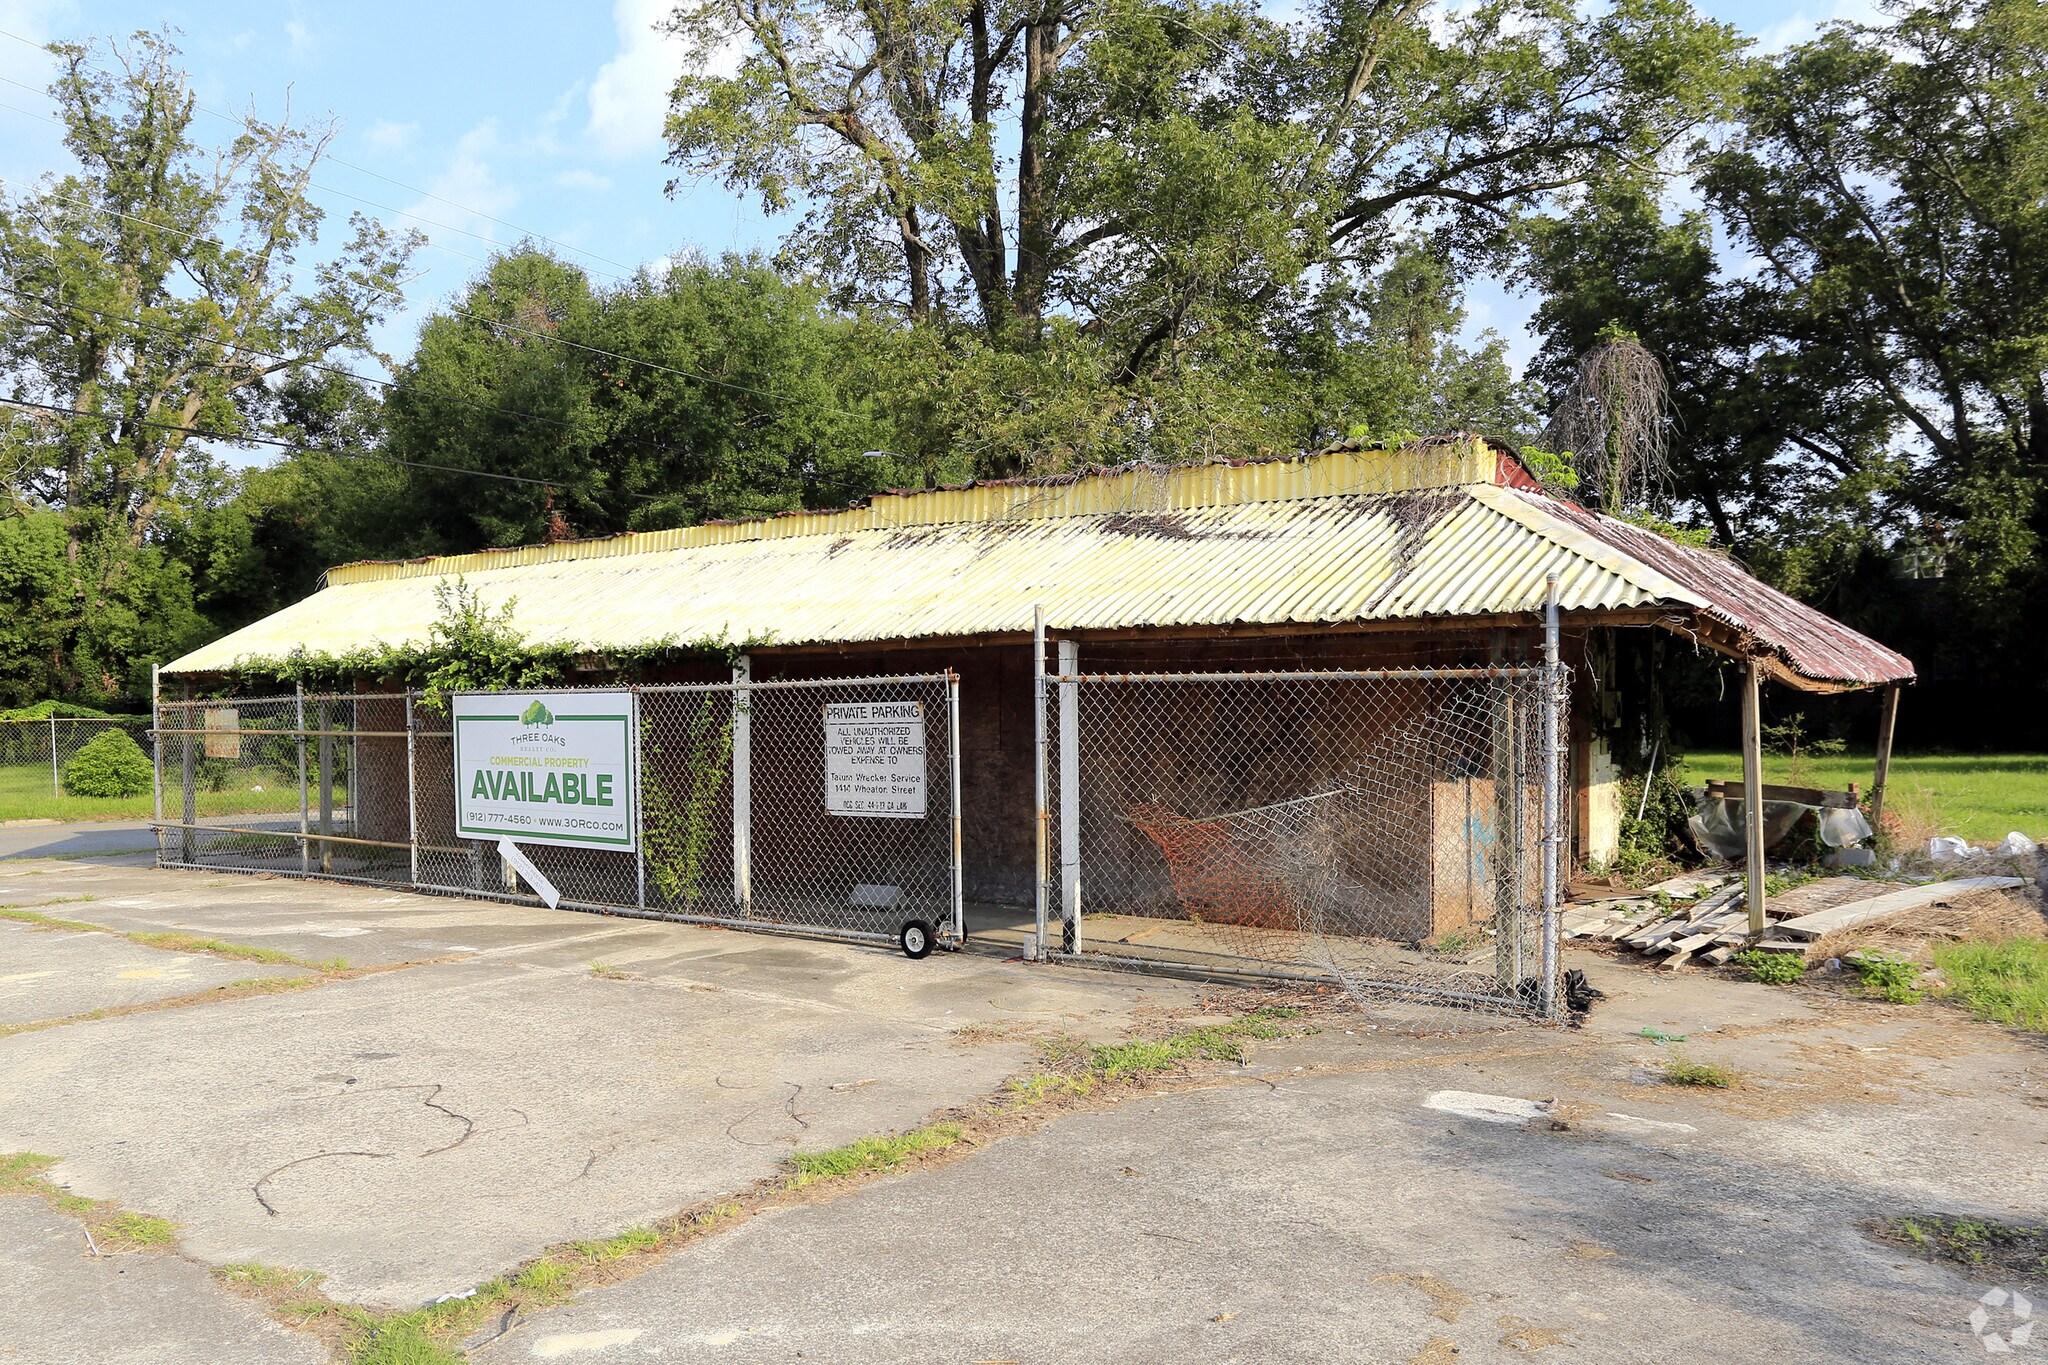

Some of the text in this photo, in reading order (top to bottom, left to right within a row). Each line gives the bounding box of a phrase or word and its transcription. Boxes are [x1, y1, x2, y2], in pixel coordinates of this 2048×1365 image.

[827, 705, 919, 719] PRIVATE PARKING
[838, 727, 911, 736] ALL UNAUTHORIZED
[511, 733, 566, 747] THREE OAKS
[840, 737, 909, 745] VEHICLES WILL BE
[828, 746, 923, 755] TOWED AWAY AT OWNERS
[490, 756, 589, 769] COMMERCIAL PROPERTY
[851, 756, 898, 765] EXPENSE TO
[856, 773, 887, 782] Wrecker
[891, 773, 920, 783] Service
[471, 769, 614, 807] AVAILABLE
[854, 785, 888, 794] Wheaton
[891, 785, 916, 794] Street
[466, 812, 486, 823] (912)
[488, 813, 531, 825] 777-4560
